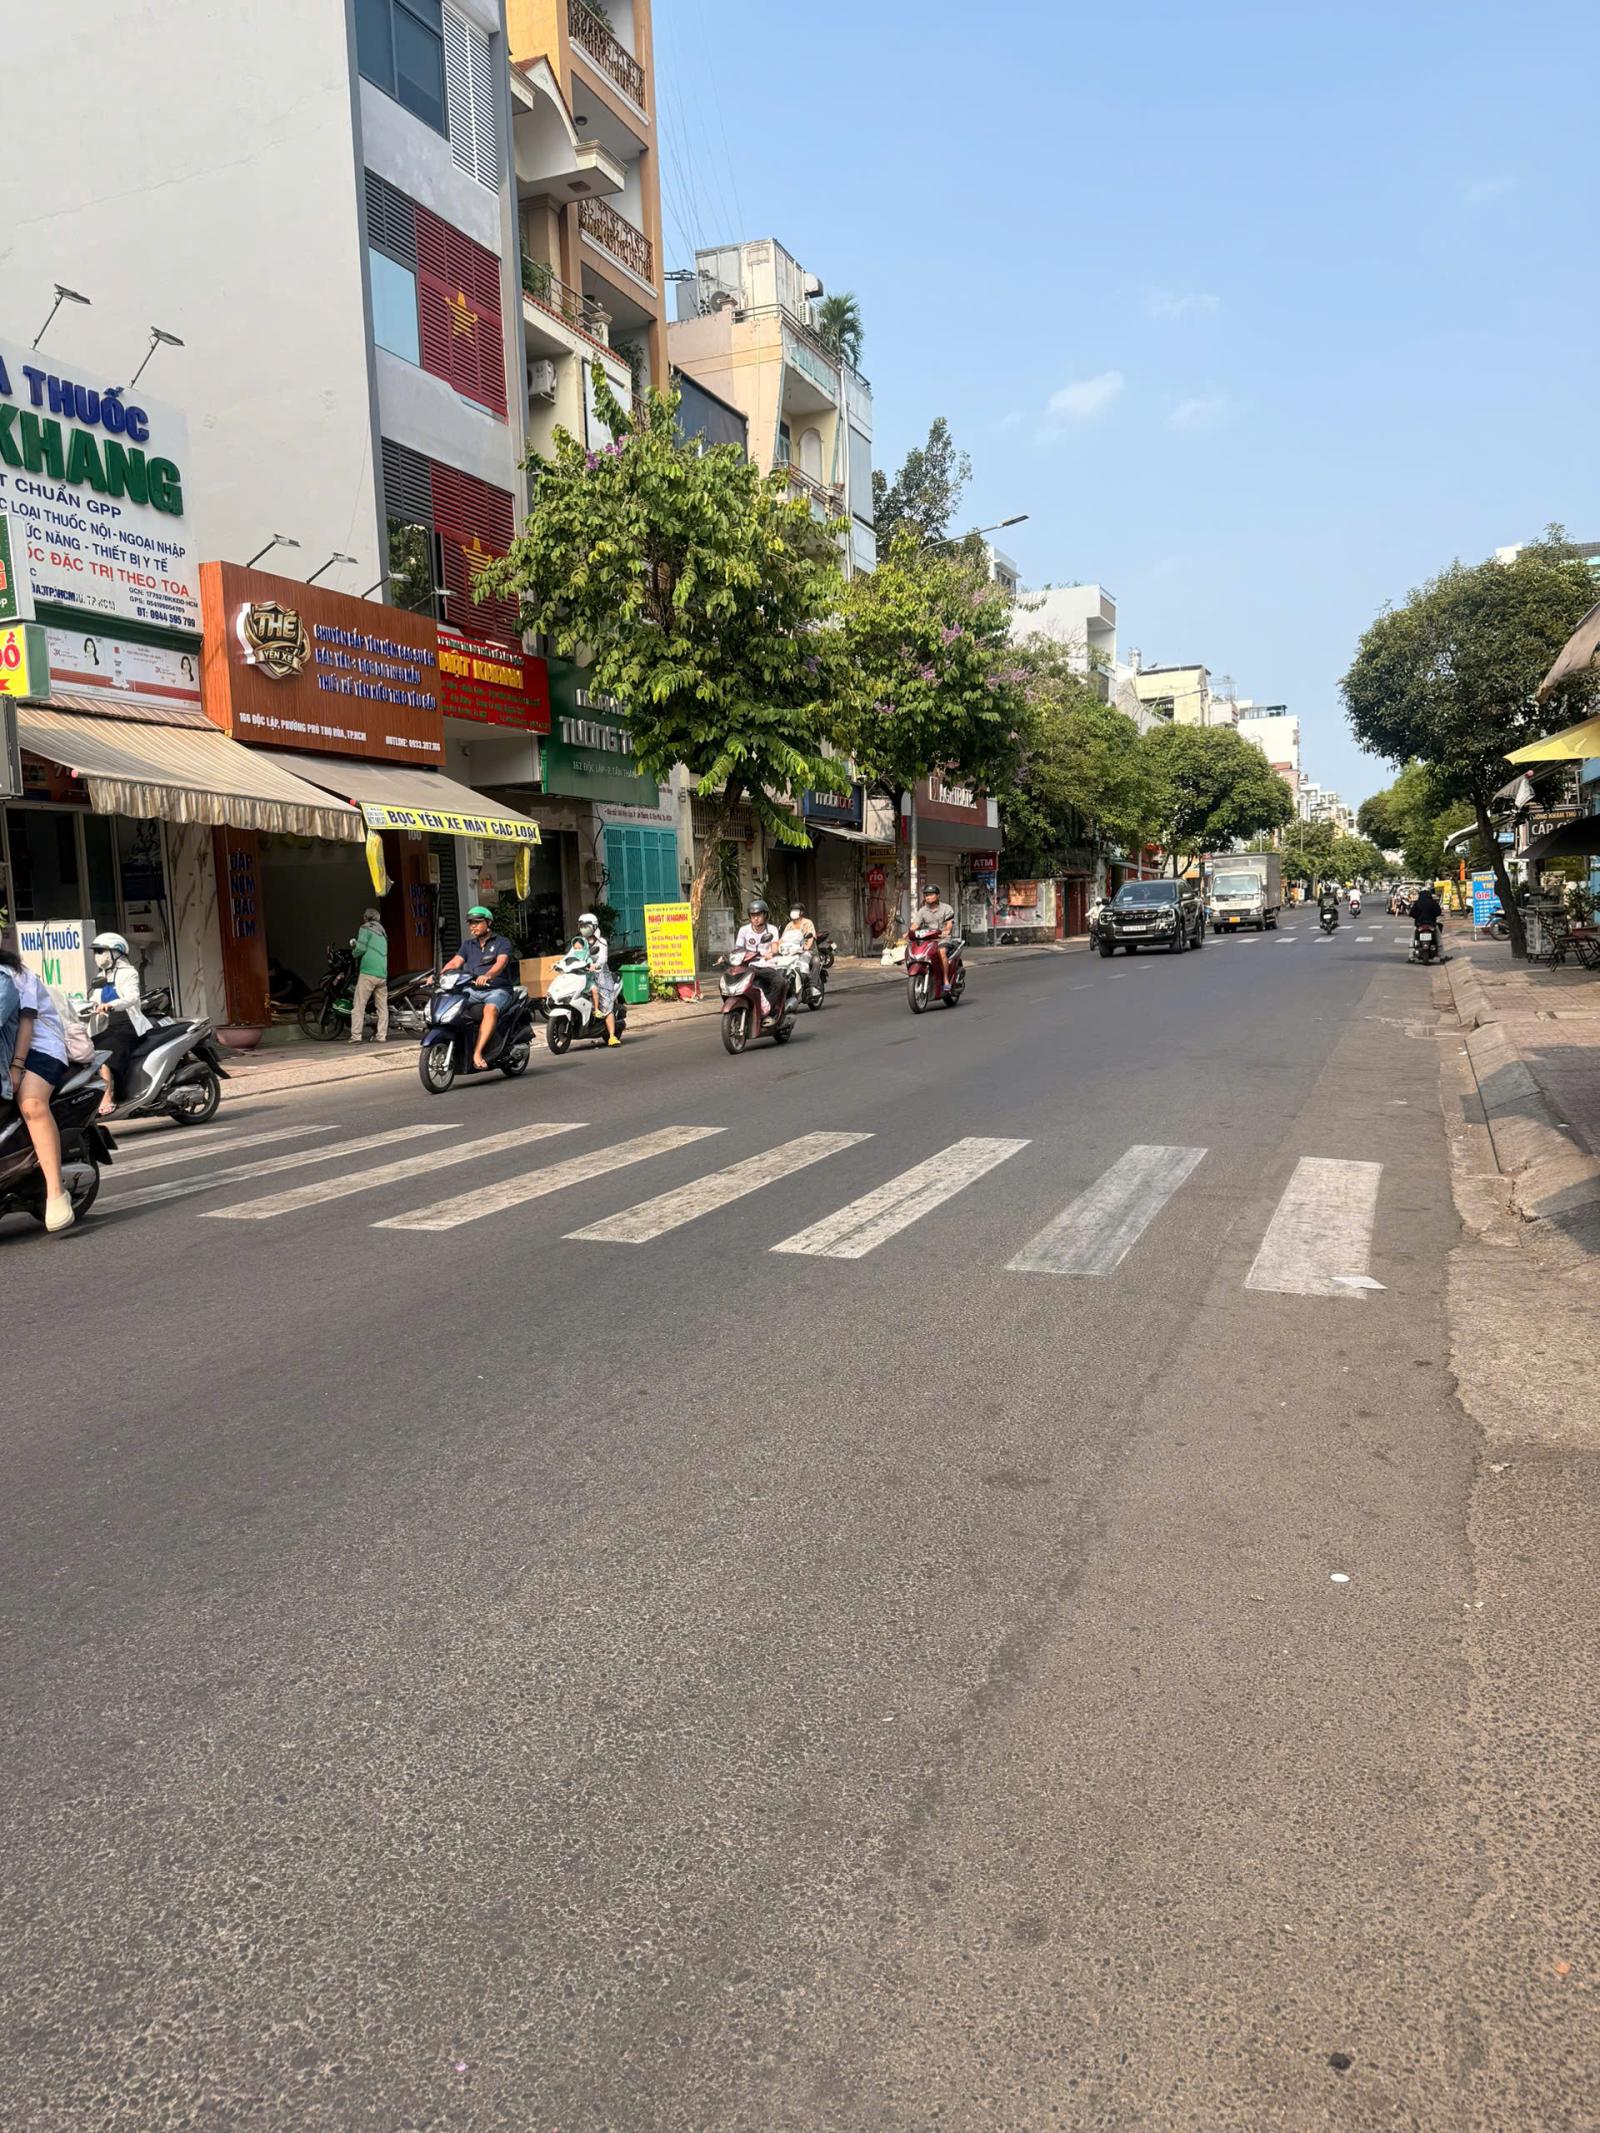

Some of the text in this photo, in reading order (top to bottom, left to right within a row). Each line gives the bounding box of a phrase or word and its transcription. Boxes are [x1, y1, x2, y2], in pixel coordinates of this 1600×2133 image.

[23, 365, 150, 442] THUỐC
[15, 477, 81, 509] CHUẨN
[87, 500, 122, 519] GPP
[12, 502, 41, 522] LOẠI
[43, 508, 87, 532] THUỐC
[90, 522, 111, 541] NỘI
[119, 530, 155, 552] NGOẠI
[157, 540, 186, 559] NHẬP
[45, 530, 81, 551] NĂNG
[92, 543, 127, 562] THIẾT
[130, 553, 141, 568] BỊ
[143, 557, 151, 568] Y
[153, 556, 169, 573] TẾ
[51, 550, 84, 573] ĐẶC
[89, 561, 114, 583] TRỊ
[117, 568, 157, 590] THEO
[161, 579, 189, 598] TOA
[137, 606, 149, 618] ĐT:
[150, 609, 168, 622] 0944
[254, 609, 297, 640] THẾ
[263, 649, 293, 664] YÊN XE
[252, 713, 265, 729] ĐỘC
[281, 718, 306, 733] PHƯỜNG
[387, 810, 416, 827] BỌC
[417, 813, 443, 828] YÊN
[445, 816, 461, 830] XE
[463, 818, 488, 833] MÁY
[491, 820, 512, 836] CÁC
[514, 825, 537, 842] LOẠI
[1531, 820, 1554, 835] CẤP
[869, 871, 883, 882] ria
[973, 858, 993, 868] ATM
[21, 923, 80, 951] NHÀ THUỐC
[43, 959, 62, 985] VI
